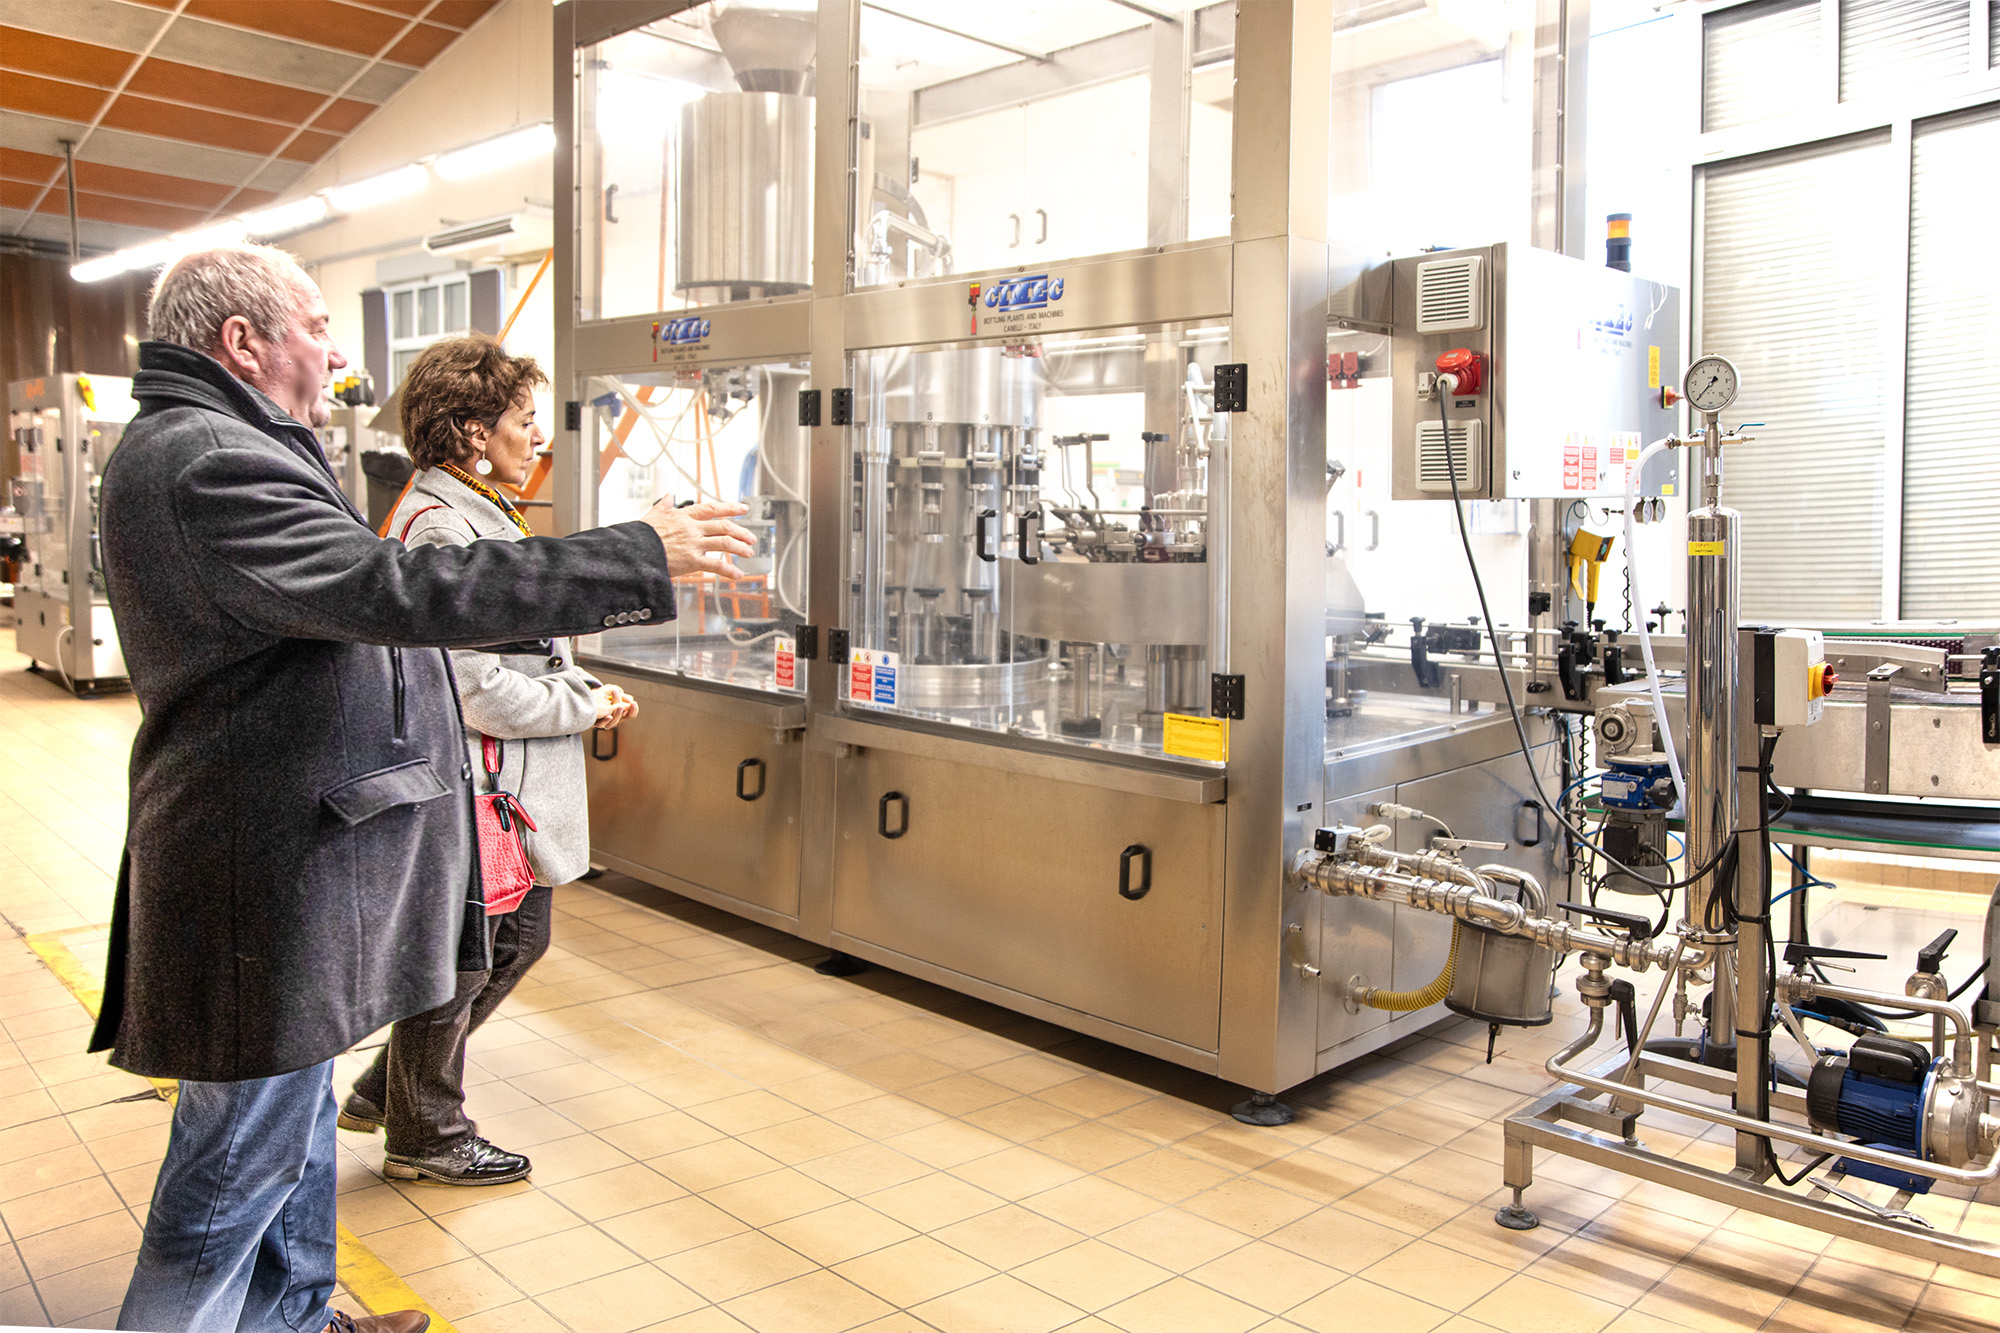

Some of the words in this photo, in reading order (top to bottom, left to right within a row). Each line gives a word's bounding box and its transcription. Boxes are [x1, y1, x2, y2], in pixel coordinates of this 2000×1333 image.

[984, 278, 1064, 308] CIMEC
[983, 315, 1006, 325] BOTTLING
[1006, 313, 1025, 323] PLANTS
[1026, 312, 1037, 321] AND
[1038, 310, 1064, 319] MACHINES
[661, 320, 710, 341] CIMEC
[1003, 324, 1023, 333] CANELLI
[1028, 322, 1042, 330] ITALY
[926, 411, 933, 421] 8
